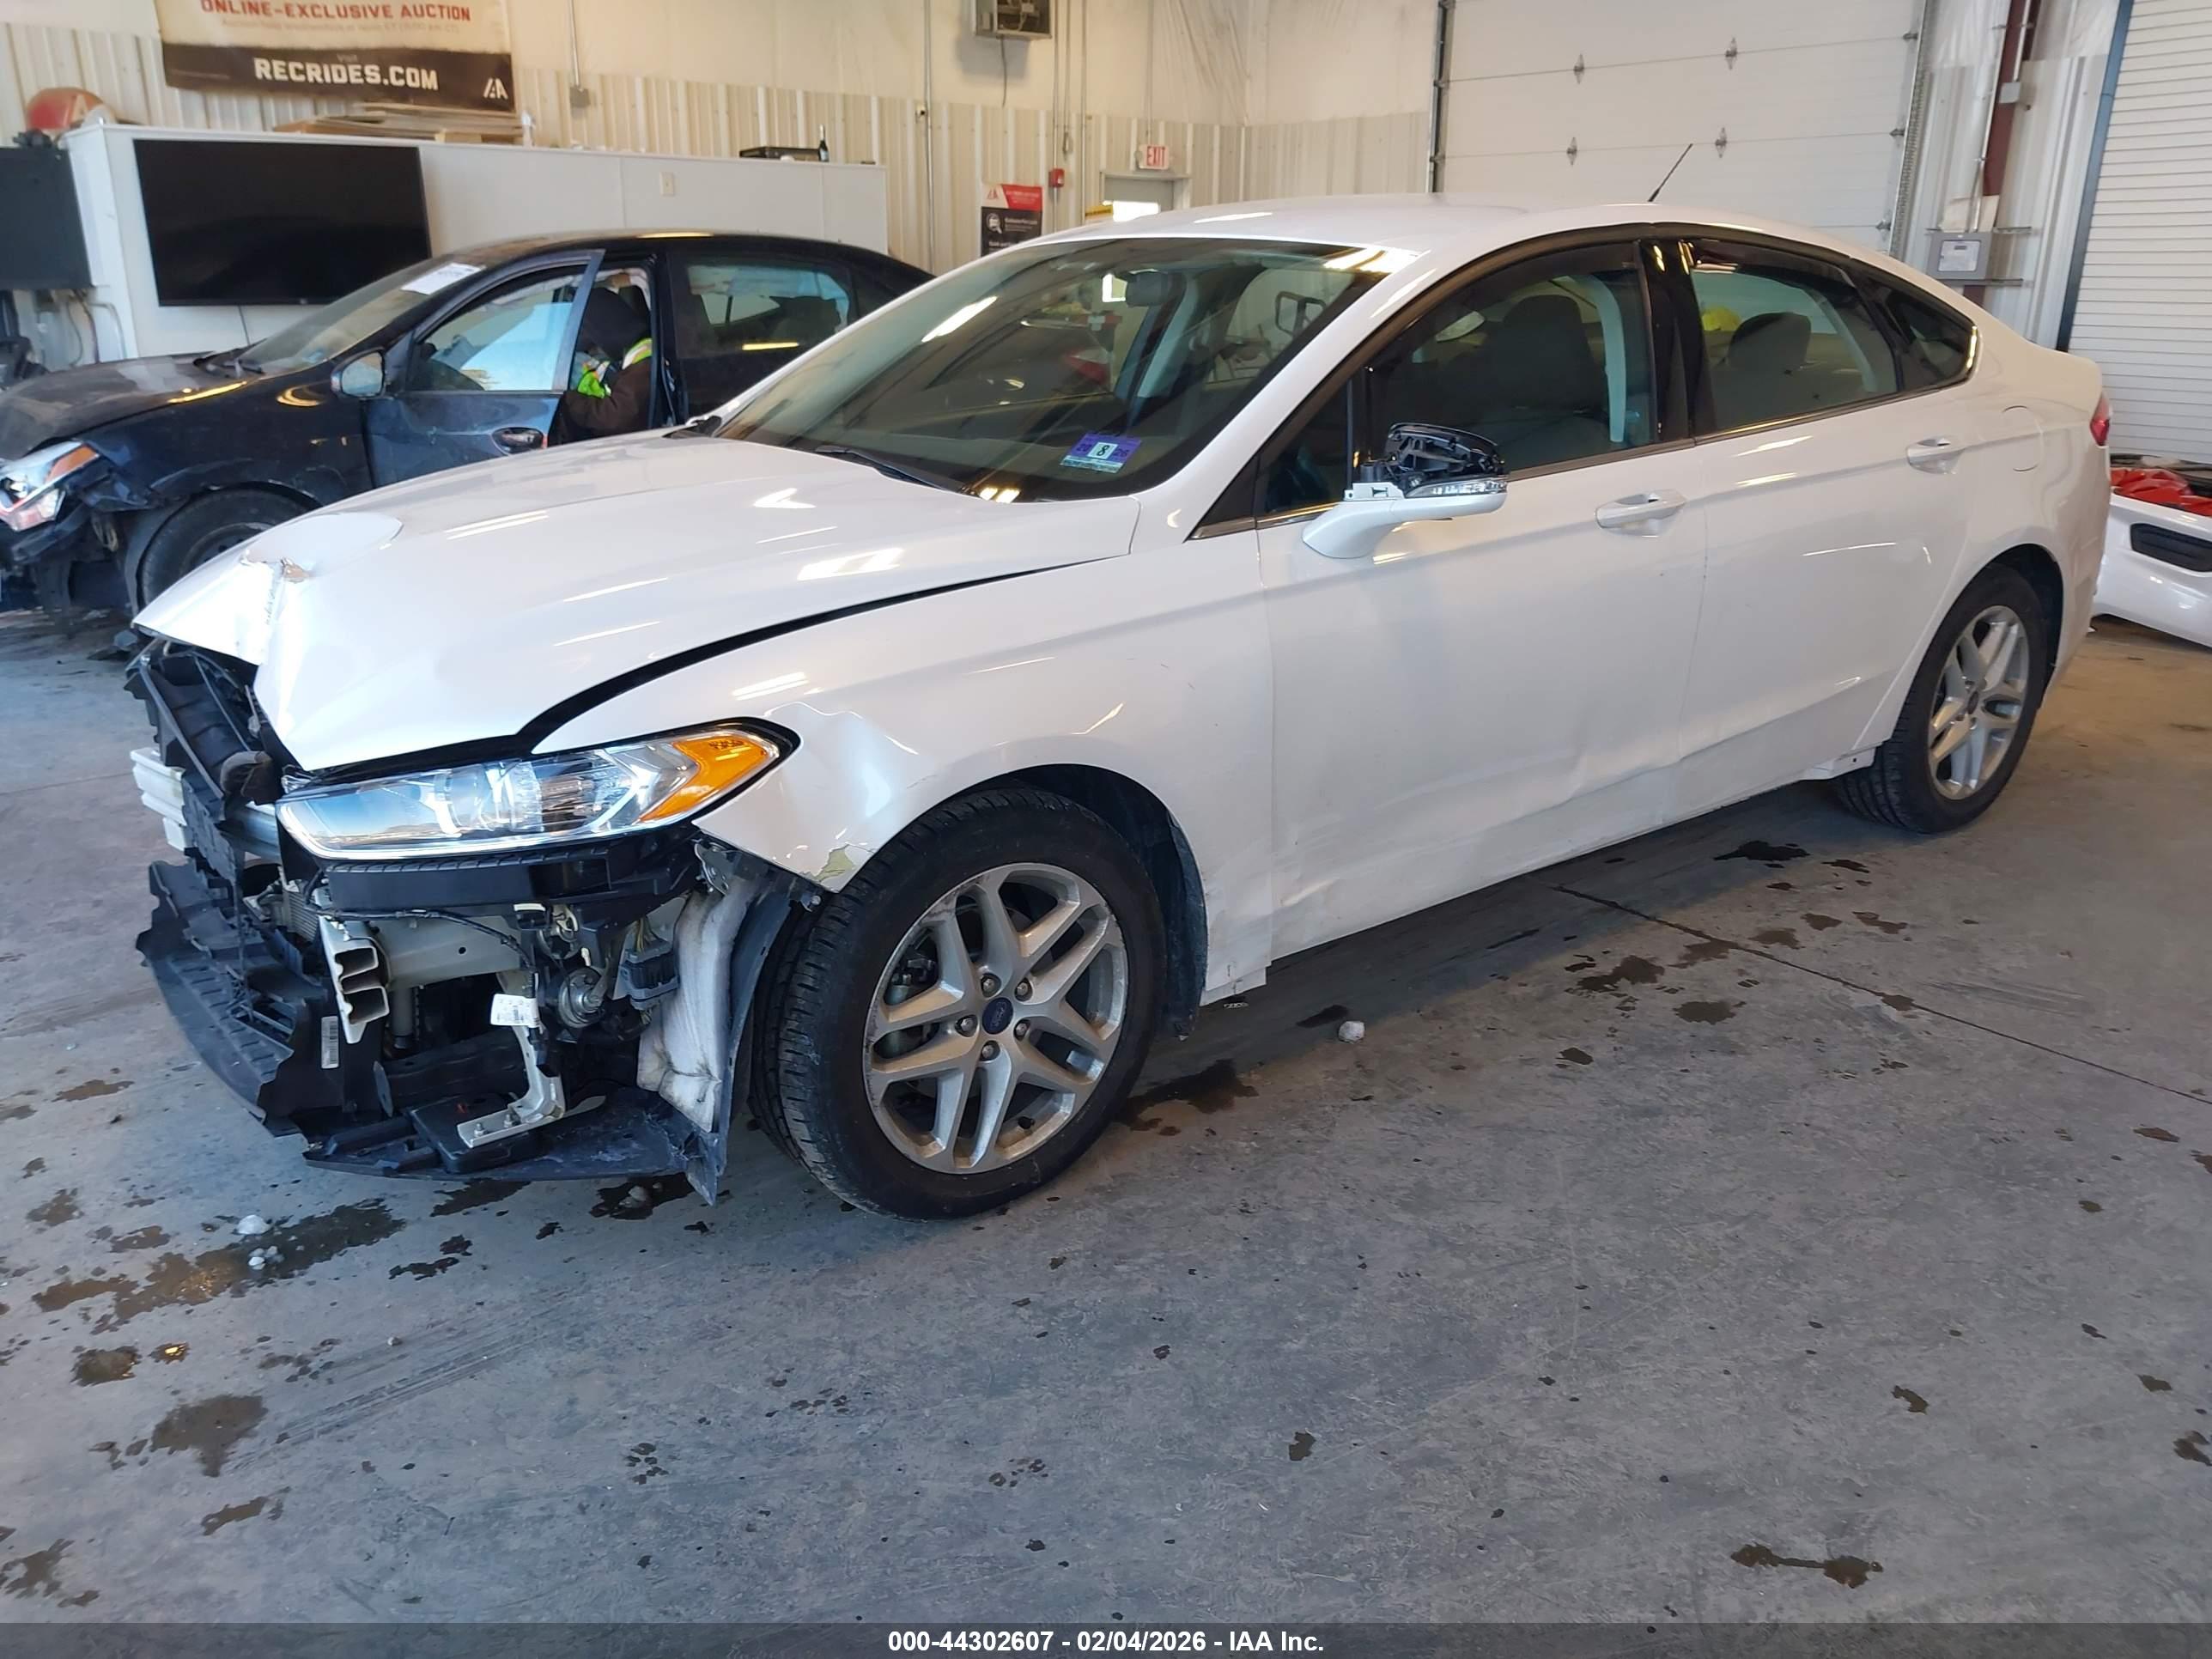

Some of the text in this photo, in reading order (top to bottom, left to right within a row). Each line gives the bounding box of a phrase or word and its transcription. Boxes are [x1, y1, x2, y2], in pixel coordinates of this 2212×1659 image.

[201, 0, 471, 21] ONLINE-EXCLUSIVE AUCTION
[253, 57, 439, 91] RECRIDES.COM
[1147, 146, 1166, 167] EXIT
[1096, 445, 1110, 457] 8
